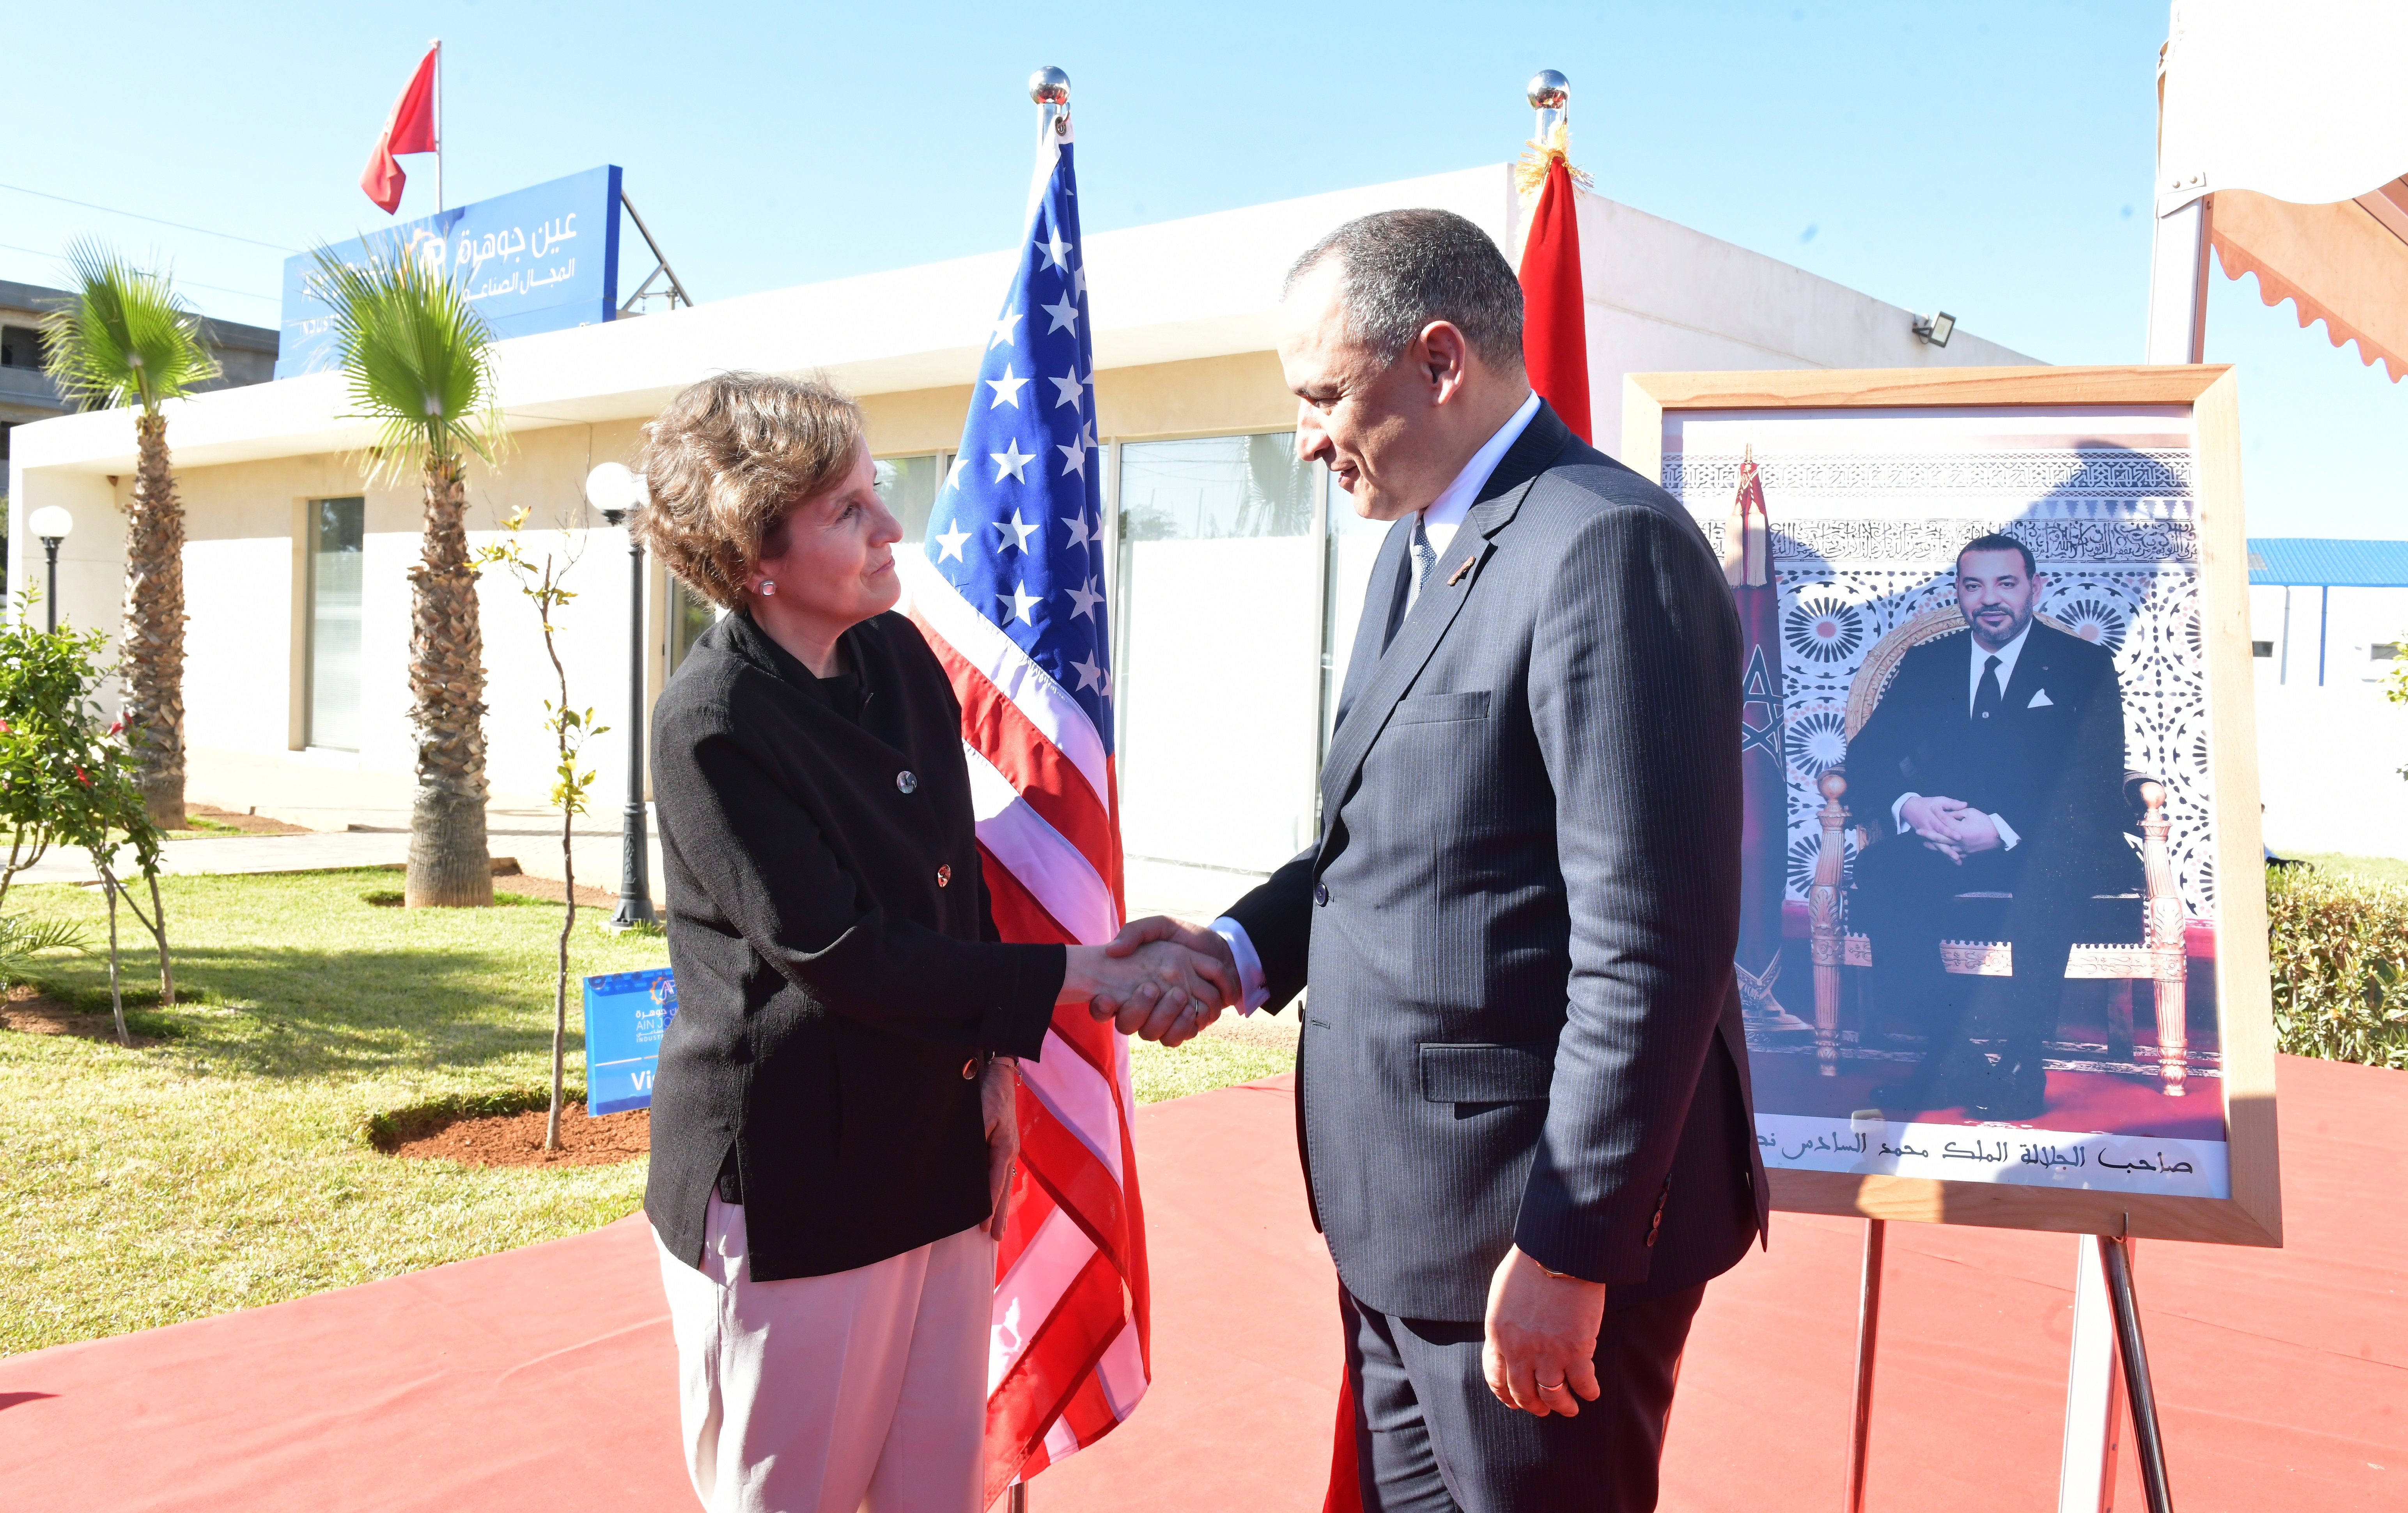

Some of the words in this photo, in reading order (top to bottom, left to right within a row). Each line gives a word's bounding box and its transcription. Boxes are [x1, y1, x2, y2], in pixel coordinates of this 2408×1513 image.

[458, 227, 526, 267] جوهرة
[532, 213, 576, 258] عين
[520, 258, 575, 295] المجال
[636, 1019, 654, 1031] AIN
[657, 1018, 672, 1028] JO
[631, 1070, 656, 1090] Vi
[1782, 1131, 1867, 1160] السادس
[1878, 1143, 1929, 1157] محمد
[1942, 1140, 2008, 1163] الملك
[2020, 1143, 2085, 1170] الجلالة
[2098, 1147, 2193, 1174] صاحب
